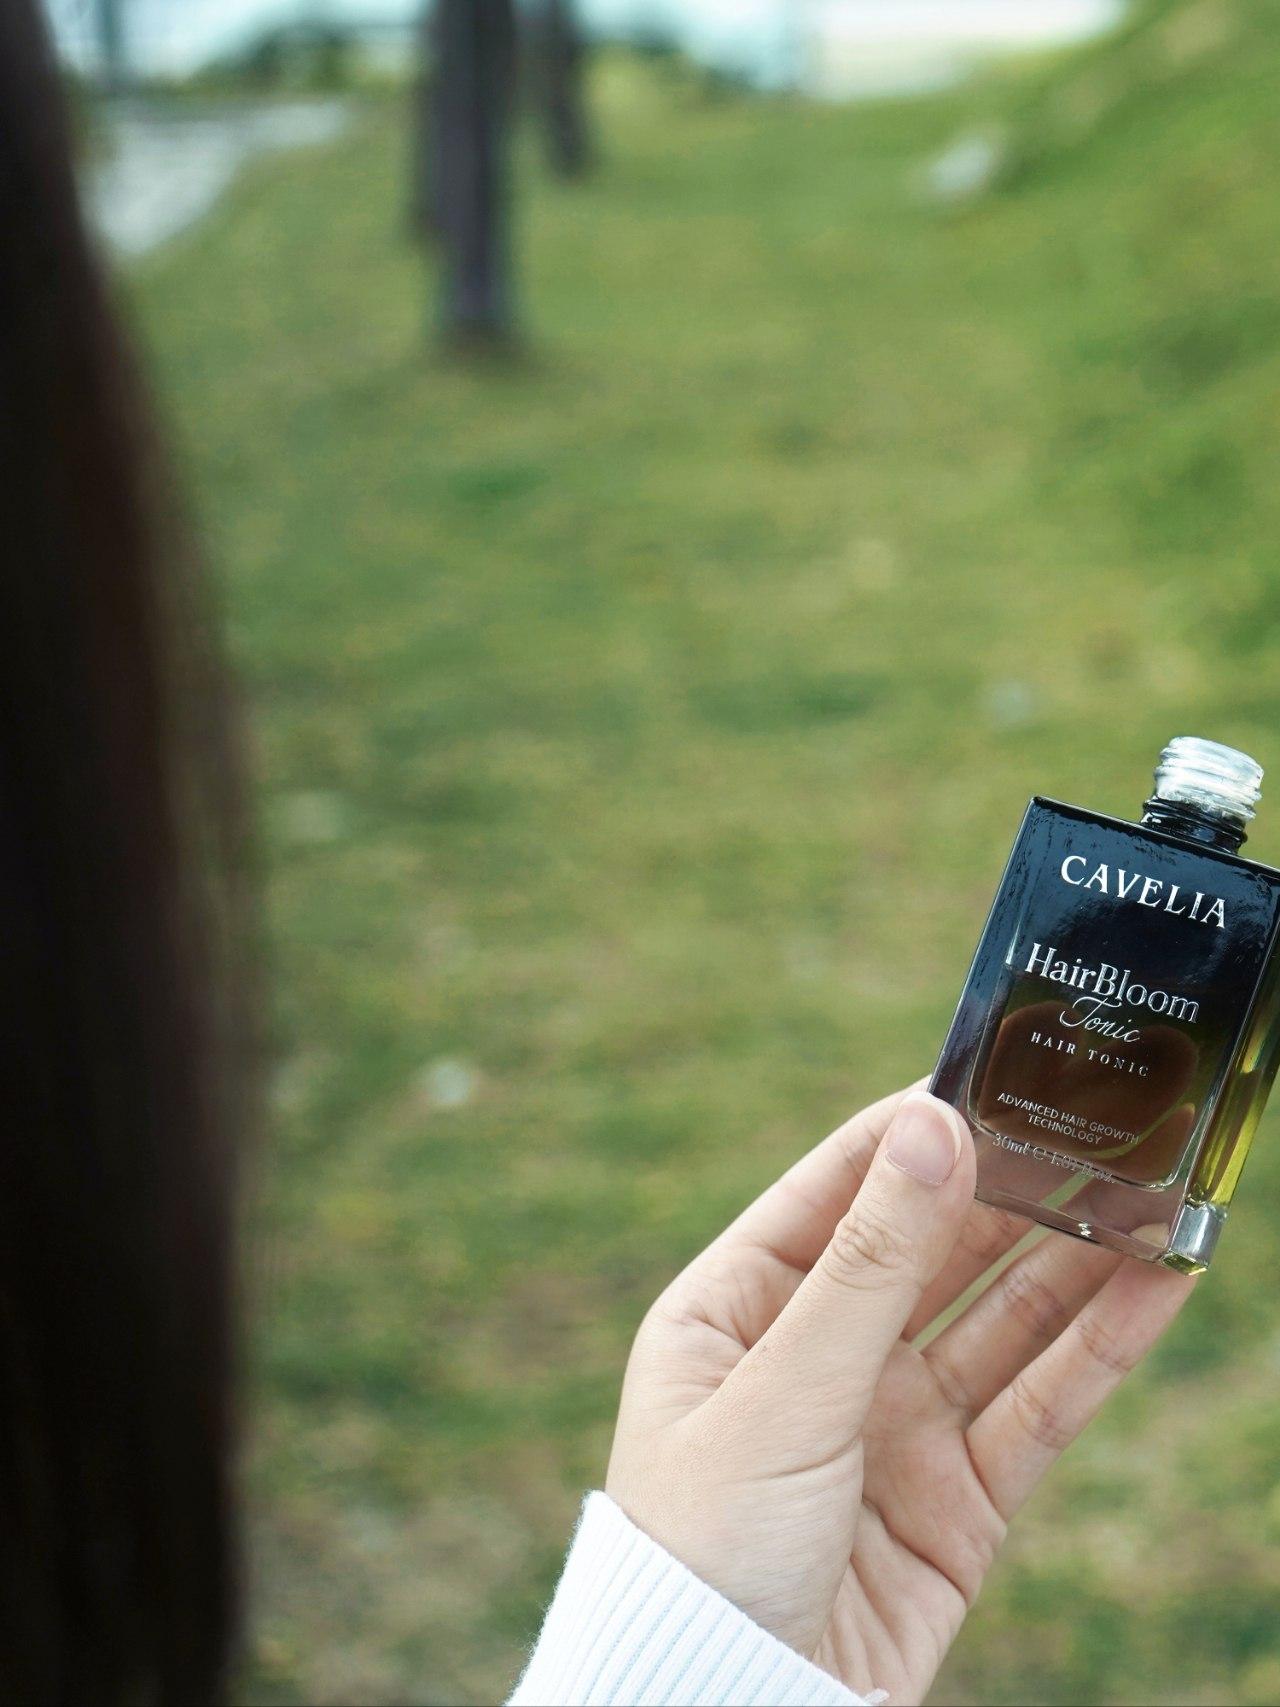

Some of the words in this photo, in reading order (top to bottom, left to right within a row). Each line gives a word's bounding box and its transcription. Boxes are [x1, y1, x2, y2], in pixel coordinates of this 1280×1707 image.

[1060, 855, 1226, 929] CAVELIA
[1025, 943, 1200, 1024] HairBloom
[1059, 996, 1141, 1043] Tonic
[1031, 1031, 1077, 1055] HAIR
[1088, 1049, 1150, 1077] TONIC
[997, 1092, 1059, 1119] ADVANCED
[1061, 1112, 1087, 1128] HAIR
[1089, 1121, 1141, 1146] GROWTH
[1028, 1113, 1102, 1145] TECHNOLOGY
